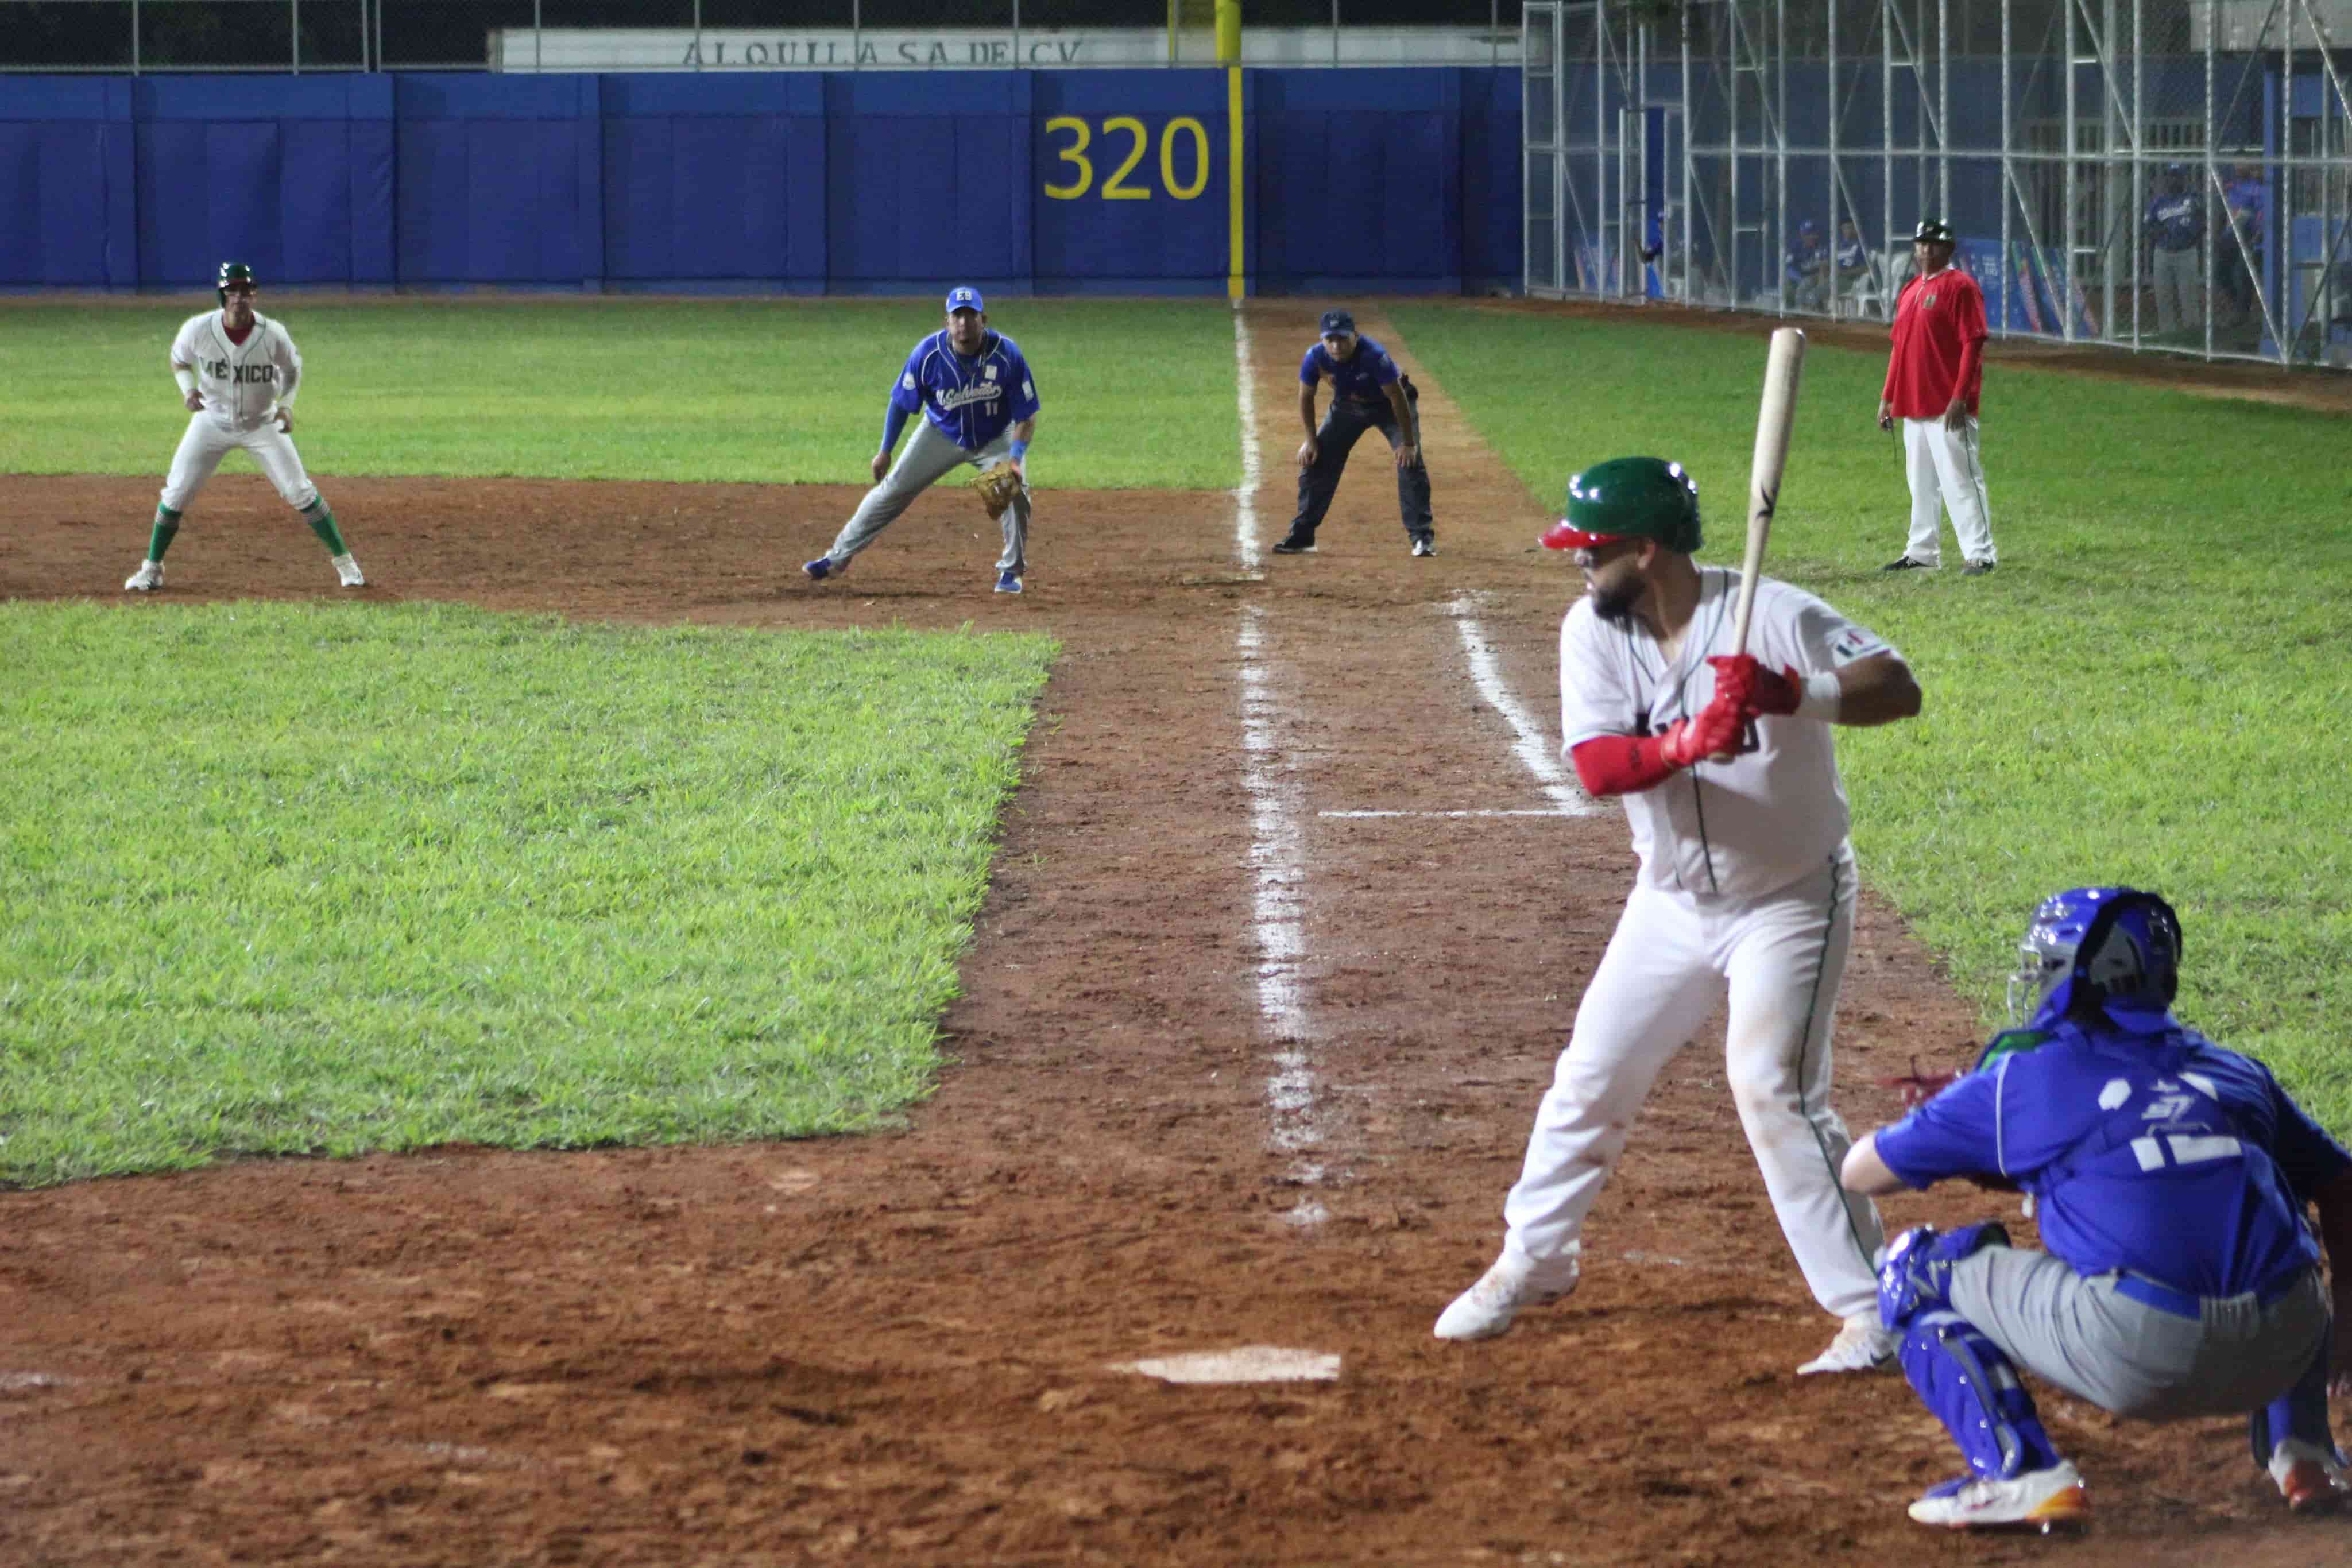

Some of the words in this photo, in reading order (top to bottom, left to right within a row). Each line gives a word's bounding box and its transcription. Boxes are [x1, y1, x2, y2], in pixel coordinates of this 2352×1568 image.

[682, 42, 878, 65] ALQUILA
[969, 42, 1009, 65] DE
[1044, 117, 1209, 199] 320
[985, 401, 999, 417] 11
